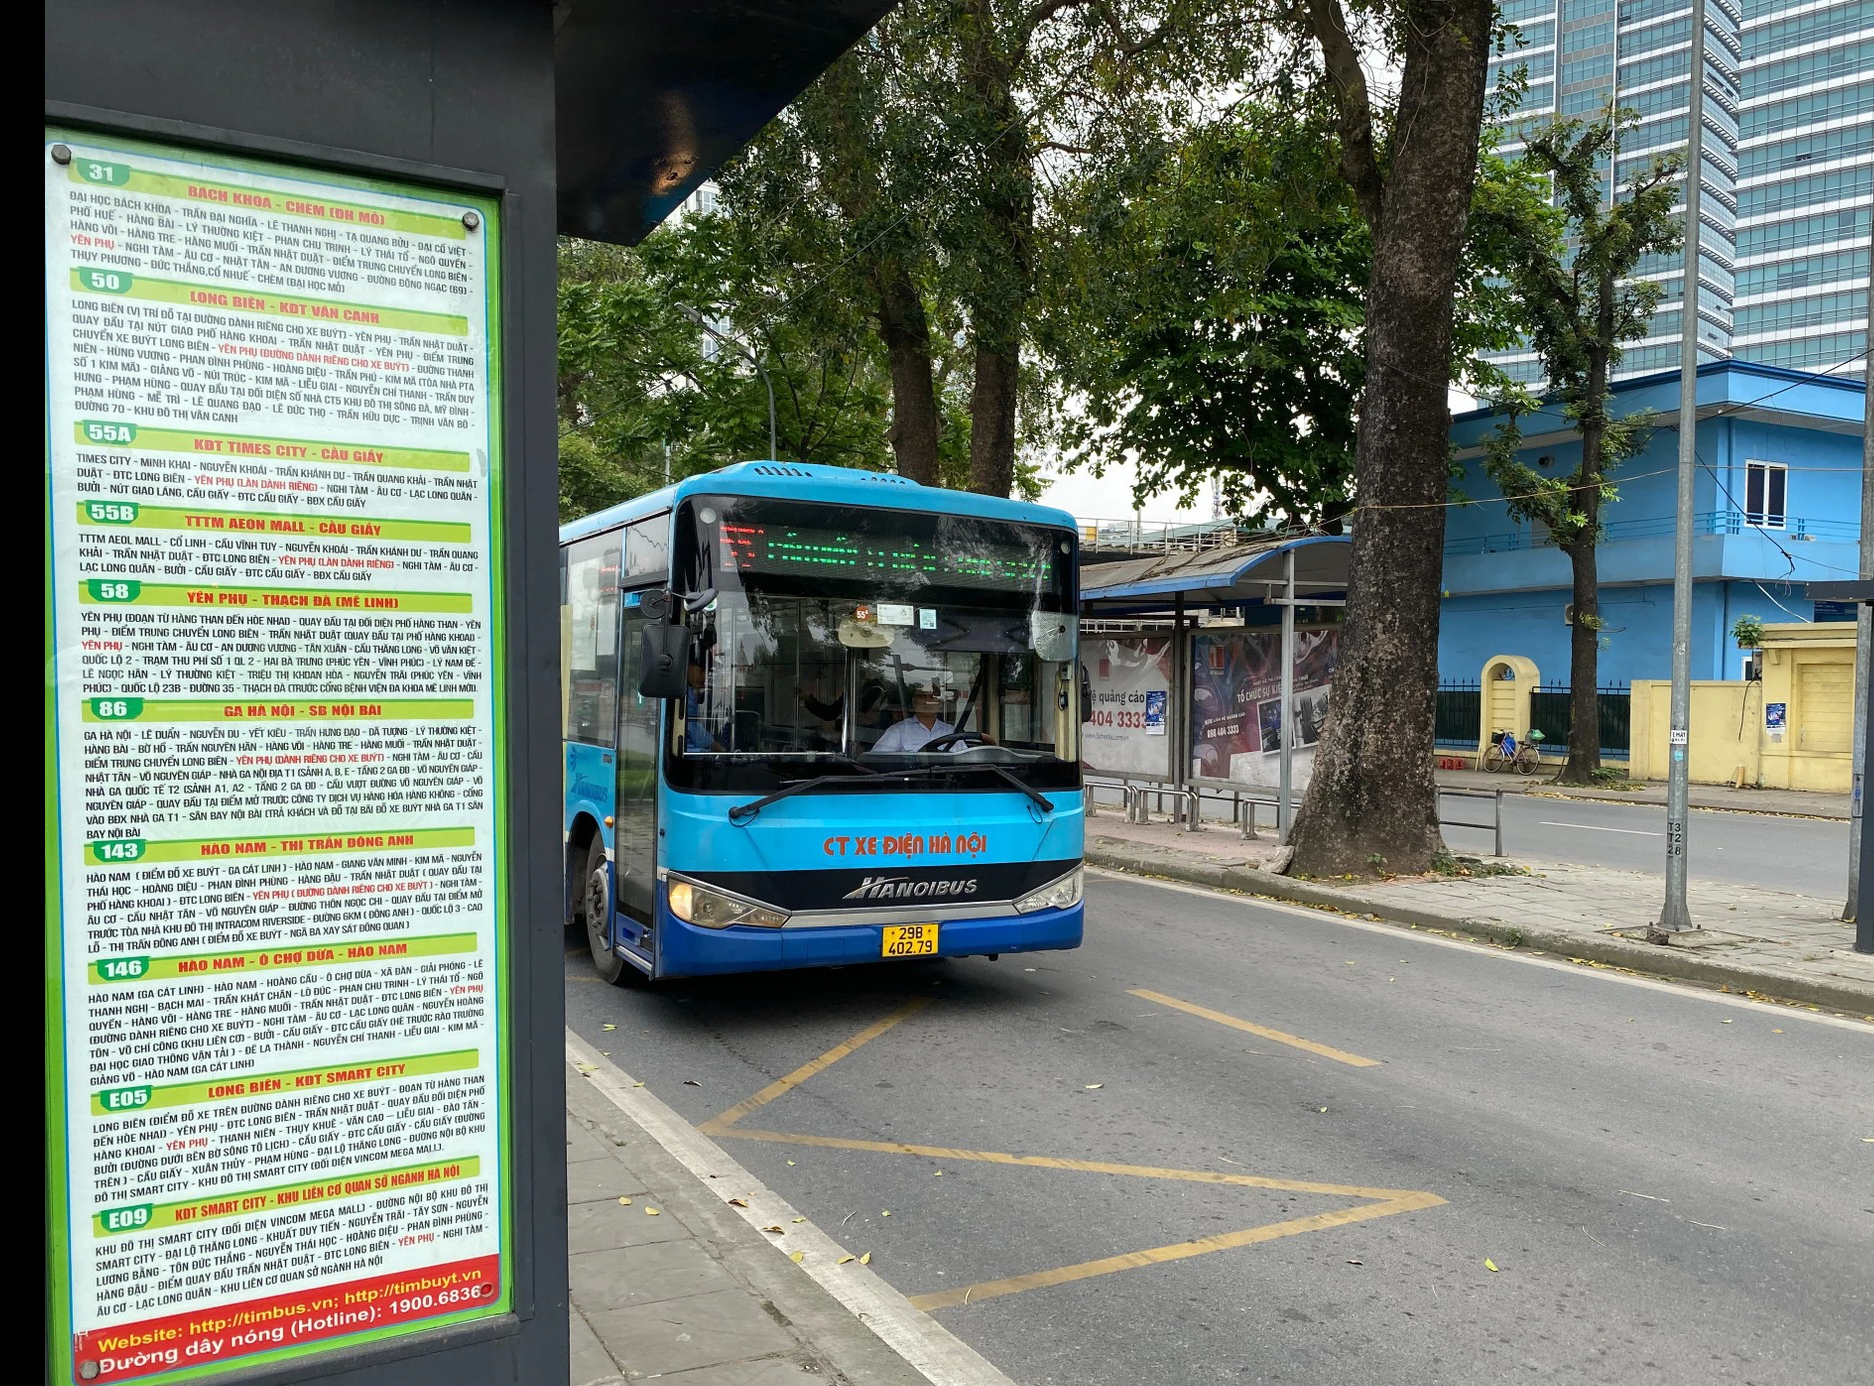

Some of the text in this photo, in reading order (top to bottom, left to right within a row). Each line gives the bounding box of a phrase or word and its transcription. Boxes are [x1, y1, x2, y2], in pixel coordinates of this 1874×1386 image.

[89, 164, 113, 182] 31
[187, 184, 228, 202] BÁCH
[231, 191, 272, 209] KHOA
[284, 200, 325, 217] CHÈM
[92, 272, 119, 290] 50
[189, 290, 228, 306] LONG
[231, 295, 266, 311] BIÊN
[310, 305, 339, 319] VÂN
[342, 308, 380, 324] CANH
[89, 424, 131, 442] 55A
[227, 440, 272, 456] TIMES
[275, 444, 307, 458] CITY
[92, 504, 134, 521] 55B
[185, 514, 224, 528] TTTM
[227, 517, 266, 531] AEON
[269, 519, 305, 533] MALL
[101, 583, 129, 599] 58
[186, 590, 214, 604] YÊN
[217, 592, 248, 605] PHỤ
[262, 593, 309, 606] THẠCH
[312, 595, 332, 607] ĐÀ
[1099, 689, 1126, 706] quảng
[1128, 690, 1145, 703] cáo
[100, 701, 127, 717] 86
[222, 703, 382, 717] GA HÀ NỘI SB NỘI BÀI
[1090, 710, 1113, 727] 404
[101, 843, 138, 859] 143
[199, 842, 230, 856] HÀO
[233, 841, 267, 854] NAM
[280, 839, 304, 851] THỊ
[346, 835, 384, 849] ĐÔNG
[386, 834, 414, 846] ANH
[824, 832, 987, 859] CT XE ĐIỆN HÀ NỘI
[842, 876, 978, 899] HANOIBUS
[898, 926, 923, 940] 29B
[888, 940, 933, 956] 402.79
[177, 959, 209, 973] HÀO
[211, 955, 246, 970] NAM
[258, 953, 269, 966] Ô
[346, 945, 374, 959] HÀO
[377, 942, 408, 955] NAM
[105, 960, 142, 977] 146
[207, 1083, 245, 1098] LONG
[248, 1078, 282, 1093] BIÊN
[325, 1067, 371, 1083] SMART
[375, 1063, 405, 1077] CITY
[110, 1089, 147, 1108] E05
[200, 1199, 238, 1217] SMART
[241, 1196, 266, 1210] CITY
[276, 1190, 299, 1205] KHU
[301, 1186, 324, 1200] LIÊN
[326, 1183, 341, 1196] CƠ
[343, 1179, 372, 1194] QUAN
[374, 1175, 388, 1188] SỞ
[389, 1170, 425, 1186] NGÀNH
[426, 1167, 441, 1180] HÀ
[442, 1164, 460, 1177] NỘI
[109, 1208, 147, 1229] E09
[98, 1270, 481, 1353] Website: http://timbus.vn; http://timbuyt.vn
[100, 1285, 481, 1374] Đường dây nóng (Hotline): 1900.6836
